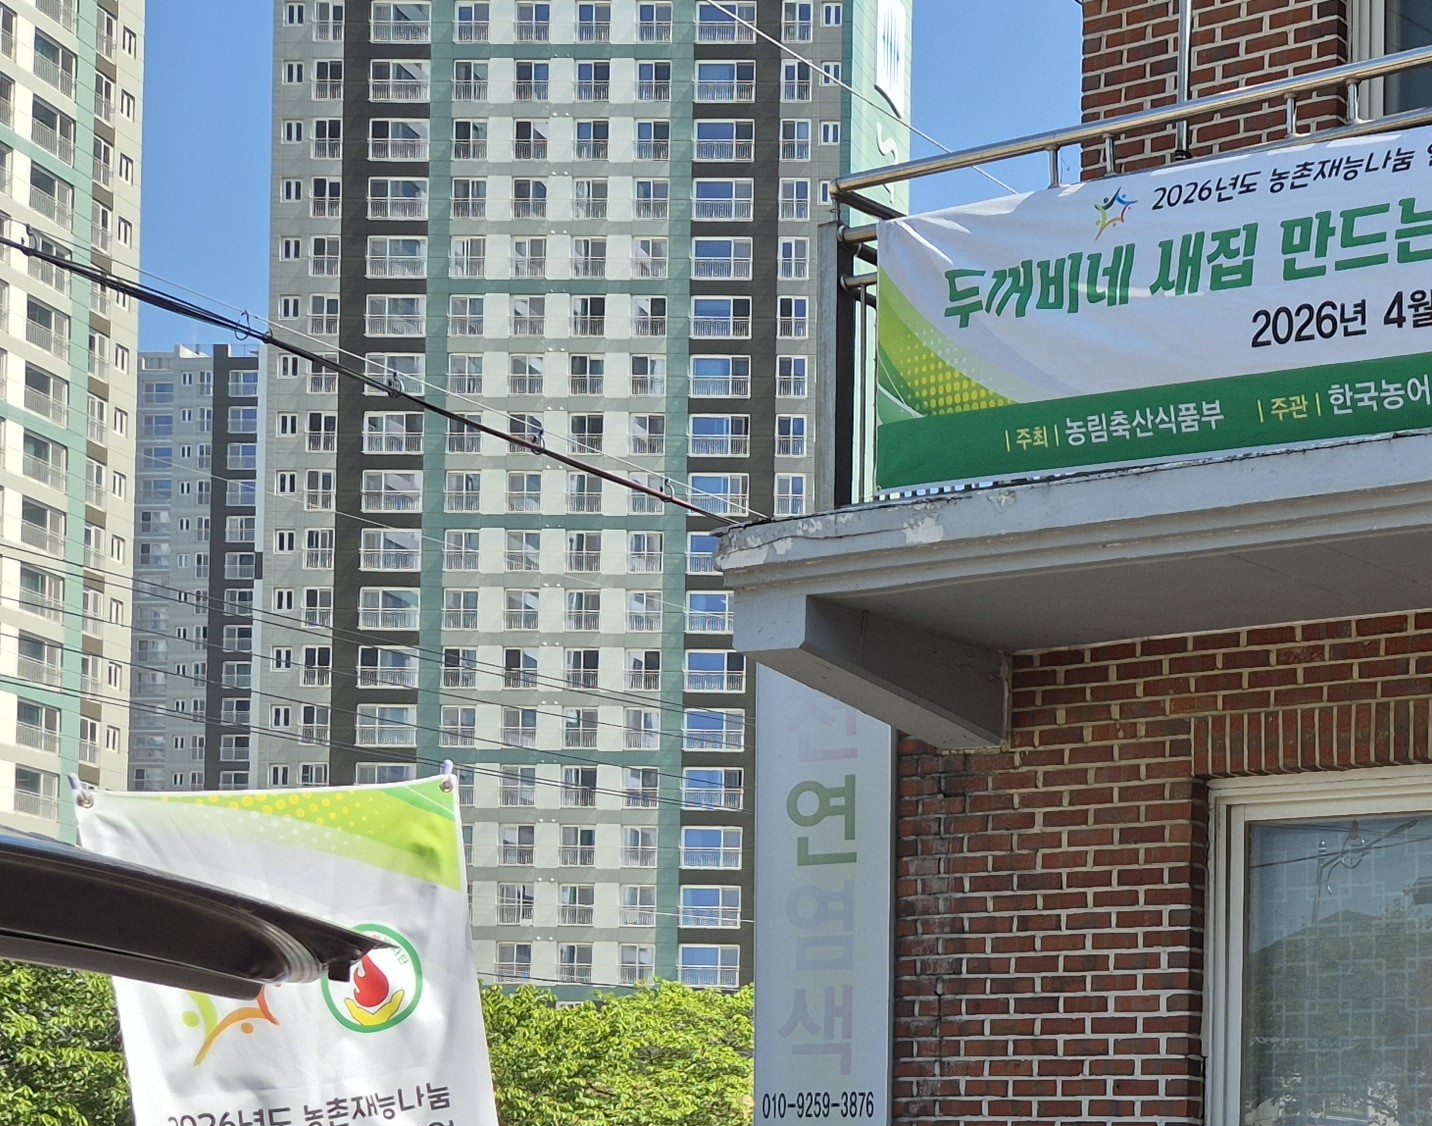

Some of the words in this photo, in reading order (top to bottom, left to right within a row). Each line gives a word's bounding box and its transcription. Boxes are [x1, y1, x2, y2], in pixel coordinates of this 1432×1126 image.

[1152, 170, 1262, 210] 2026년도
[1269, 143, 1415, 195] 농촌재능나눔
[944, 242, 1135, 328] 두꺼비네
[1151, 222, 1259, 297] 새집
[1251, 299, 1368, 348] 2026년
[1015, 425, 1049, 451] 주최
[1064, 399, 1225, 446] 농림축산식품부
[1270, 394, 1308, 421] 주관
[762, 1091, 875, 1119] 010-9259-3876
